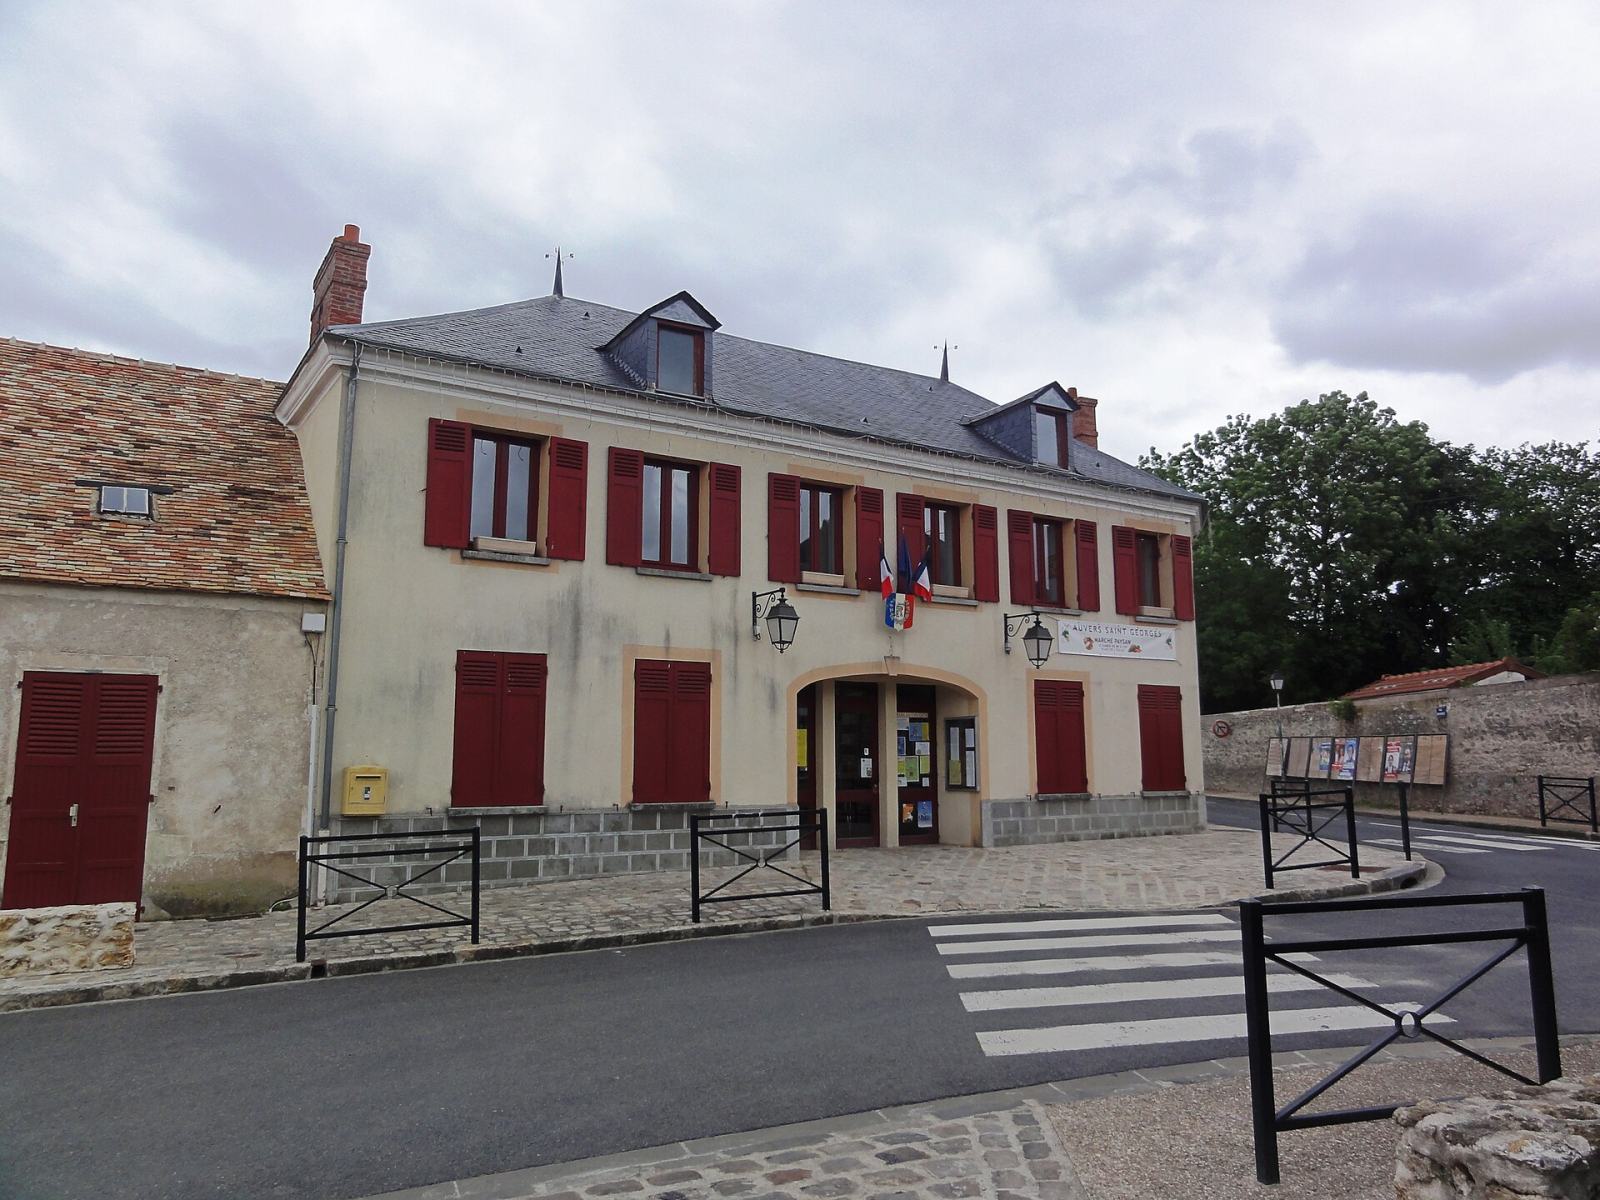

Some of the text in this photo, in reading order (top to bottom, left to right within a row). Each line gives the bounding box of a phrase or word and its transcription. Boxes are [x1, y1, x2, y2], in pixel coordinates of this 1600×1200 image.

[1072, 624, 1162, 638] AUVERS SAINT GEORGES
